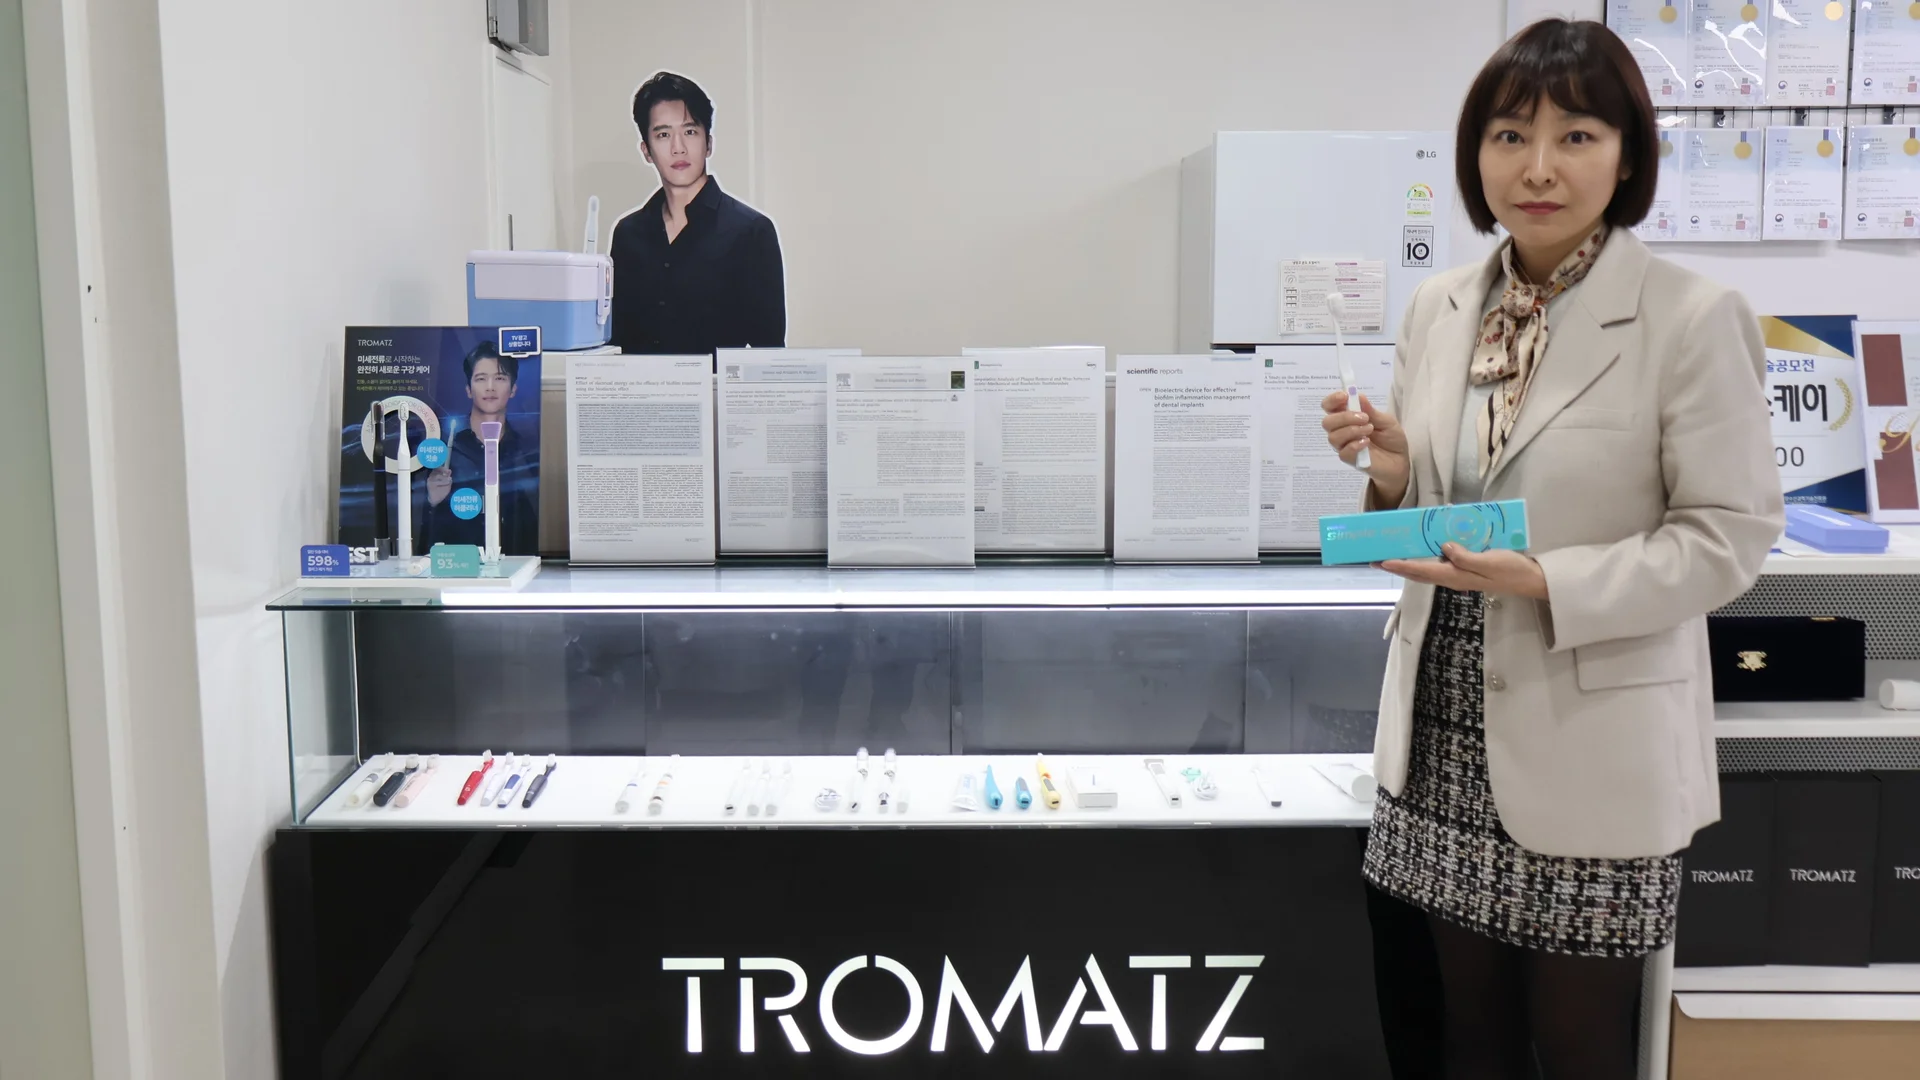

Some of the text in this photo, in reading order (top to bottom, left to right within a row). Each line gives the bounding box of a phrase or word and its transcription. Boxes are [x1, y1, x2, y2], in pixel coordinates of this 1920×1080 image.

[1406, 242, 1430, 260] 10
[357, 339, 393, 347] TROMATZ
[357, 355, 421, 364] 미세전류로 시작하는
[1766, 359, 1815, 373] 술공모전
[357, 365, 430, 374] 완전히 새로운 구강 케어
[1765, 384, 1828, 422] 케이
[1775, 446, 1805, 467] 00
[308, 555, 340, 566] 598%
[1690, 870, 1754, 883] TROMATZ
[1789, 868, 1856, 883] TROMATZ
[1894, 866, 1920, 880] TRO
[661, 953, 1265, 1055] TROMATZ
